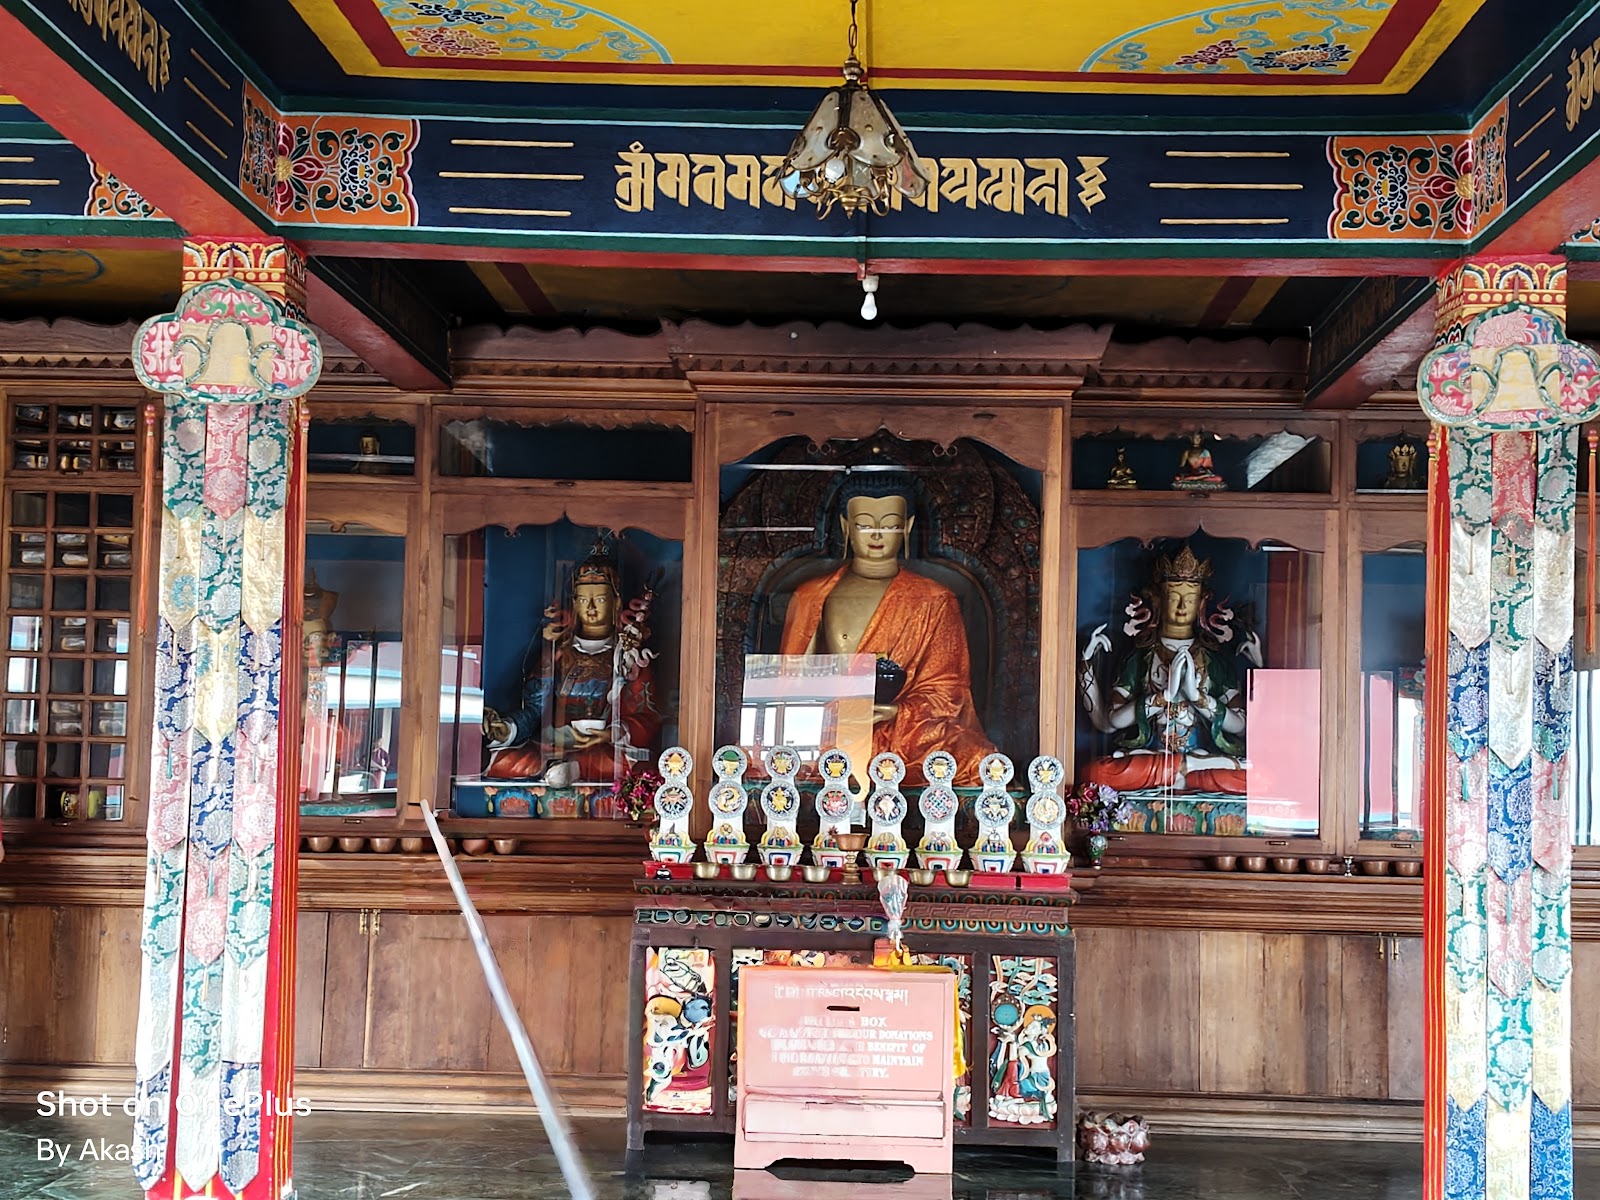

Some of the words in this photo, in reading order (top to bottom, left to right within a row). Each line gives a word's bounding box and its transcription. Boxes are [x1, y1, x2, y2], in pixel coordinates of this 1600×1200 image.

[860, 1016, 888, 1027] BOX
[878, 1030, 934, 1041] DONATIONS
[867, 1041, 908, 1053] BENEFIT
[911, 1043, 927, 1053] OF
[872, 1054, 924, 1066] MAINTAIN
